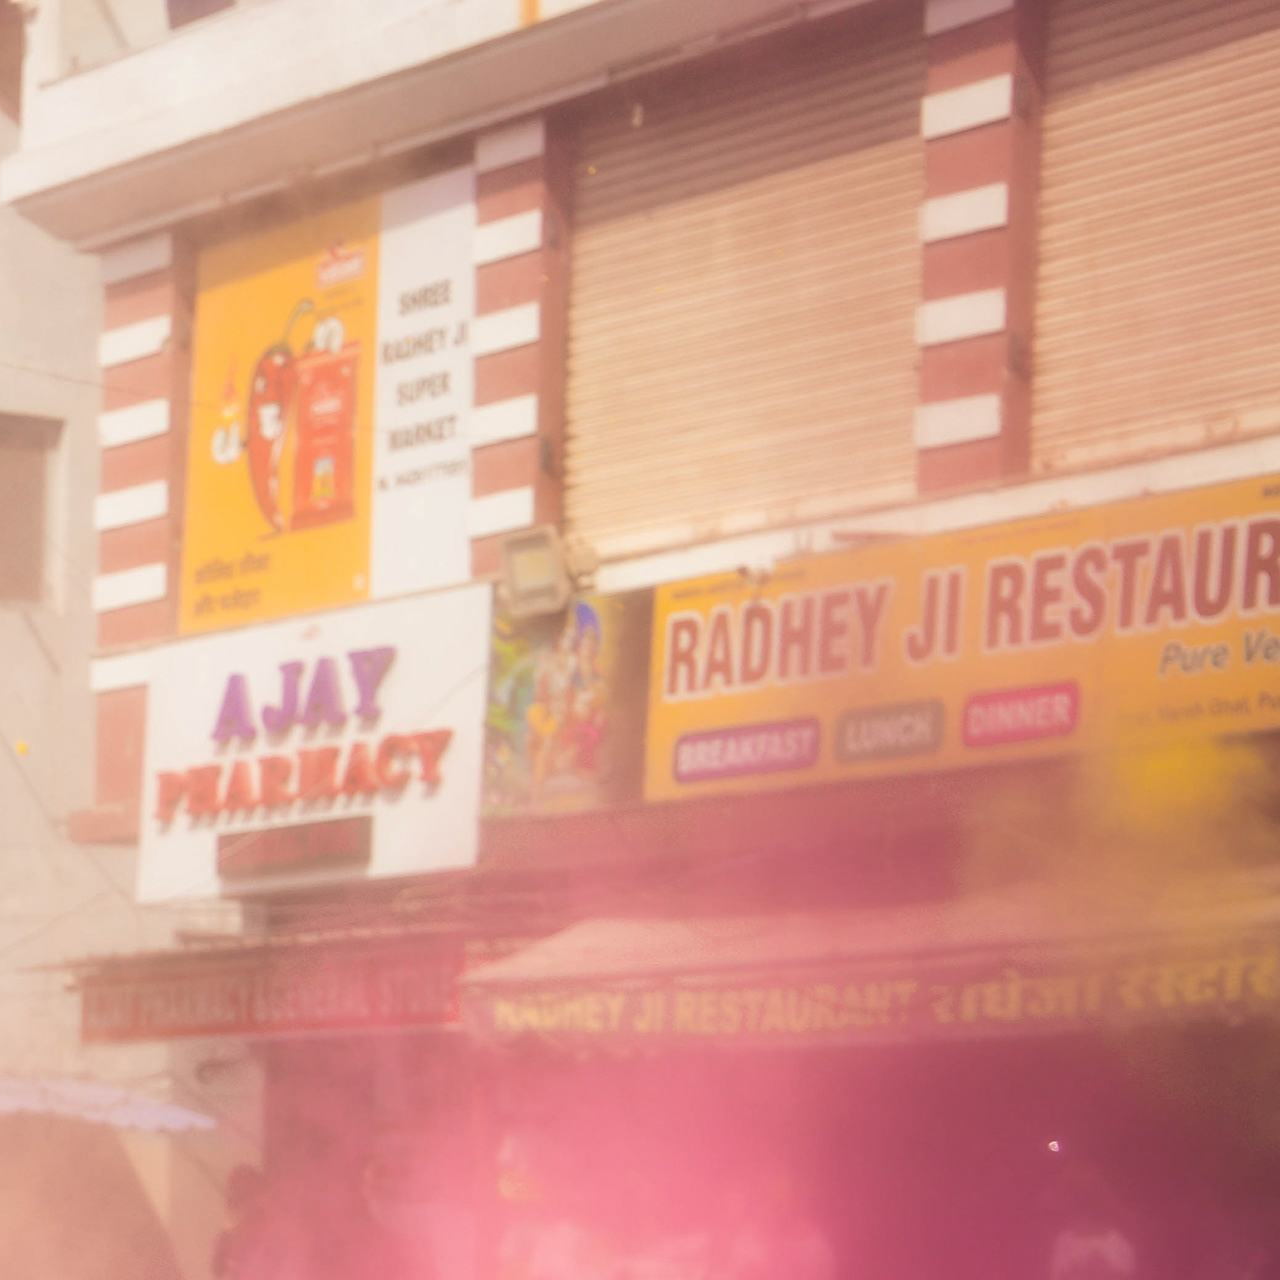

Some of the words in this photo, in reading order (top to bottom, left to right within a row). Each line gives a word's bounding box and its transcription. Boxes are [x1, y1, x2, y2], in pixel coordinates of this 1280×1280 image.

[399, 278, 454, 317] SHREE
[382, 327, 449, 366] RADHEY
[453, 322, 470, 347] JI
[396, 370, 452, 406] SUPER
[388, 413, 458, 452] MARKET
[666, 578, 892, 696] RADHEY
[903, 569, 962, 663] JI
[985, 515, 1280, 650] RESTAUR
[1159, 640, 1230, 678] Pure
[210, 643, 398, 745] AJAY
[678, 729, 814, 775] BREAKFAST
[846, 709, 933, 754] LUNCH
[968, 692, 1072, 736] DINNER
[154, 726, 454, 828] PHARMACY
[492, 991, 626, 1033] RADHEY
[633, 990, 667, 1033] JI
[673, 978, 916, 1035] RESTAURANT
